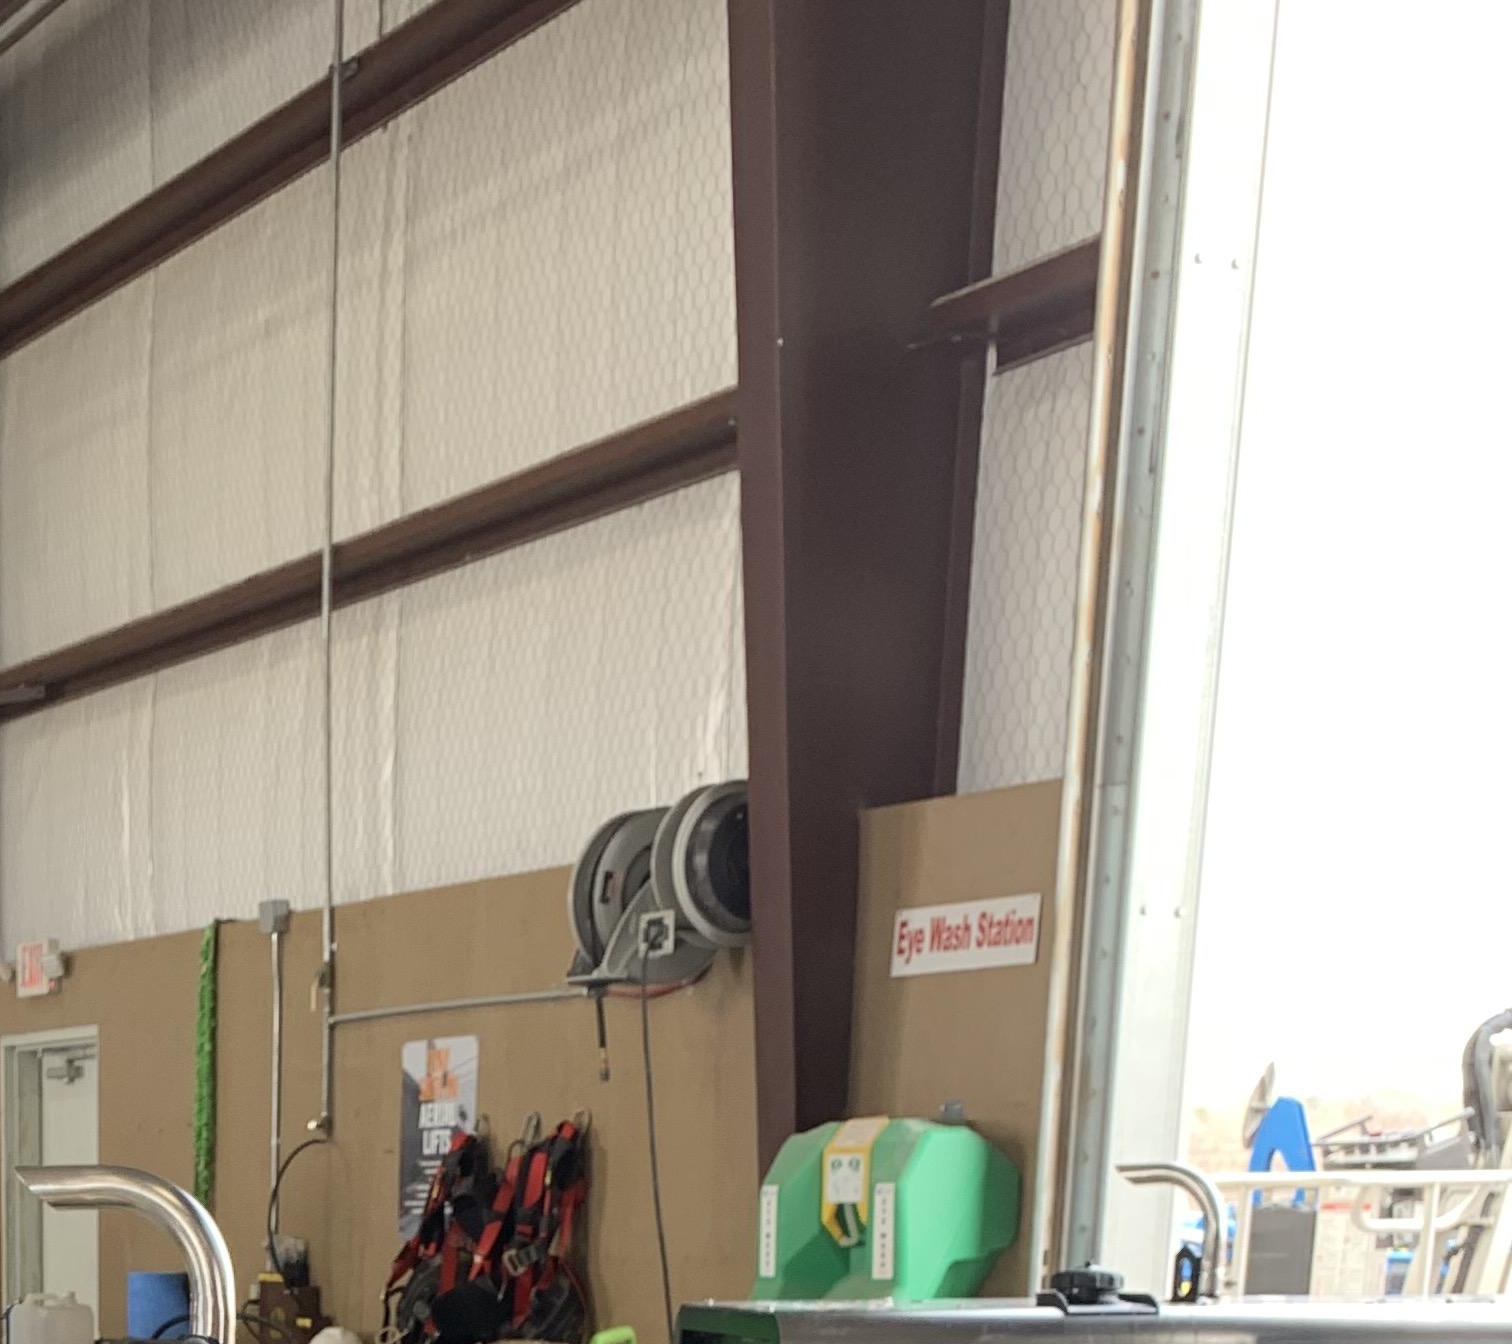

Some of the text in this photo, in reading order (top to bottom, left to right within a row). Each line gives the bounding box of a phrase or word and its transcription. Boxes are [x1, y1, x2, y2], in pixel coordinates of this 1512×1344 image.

[896, 909, 1035, 964] Eye Wash Station
[21, 944, 44, 986] EXIT
